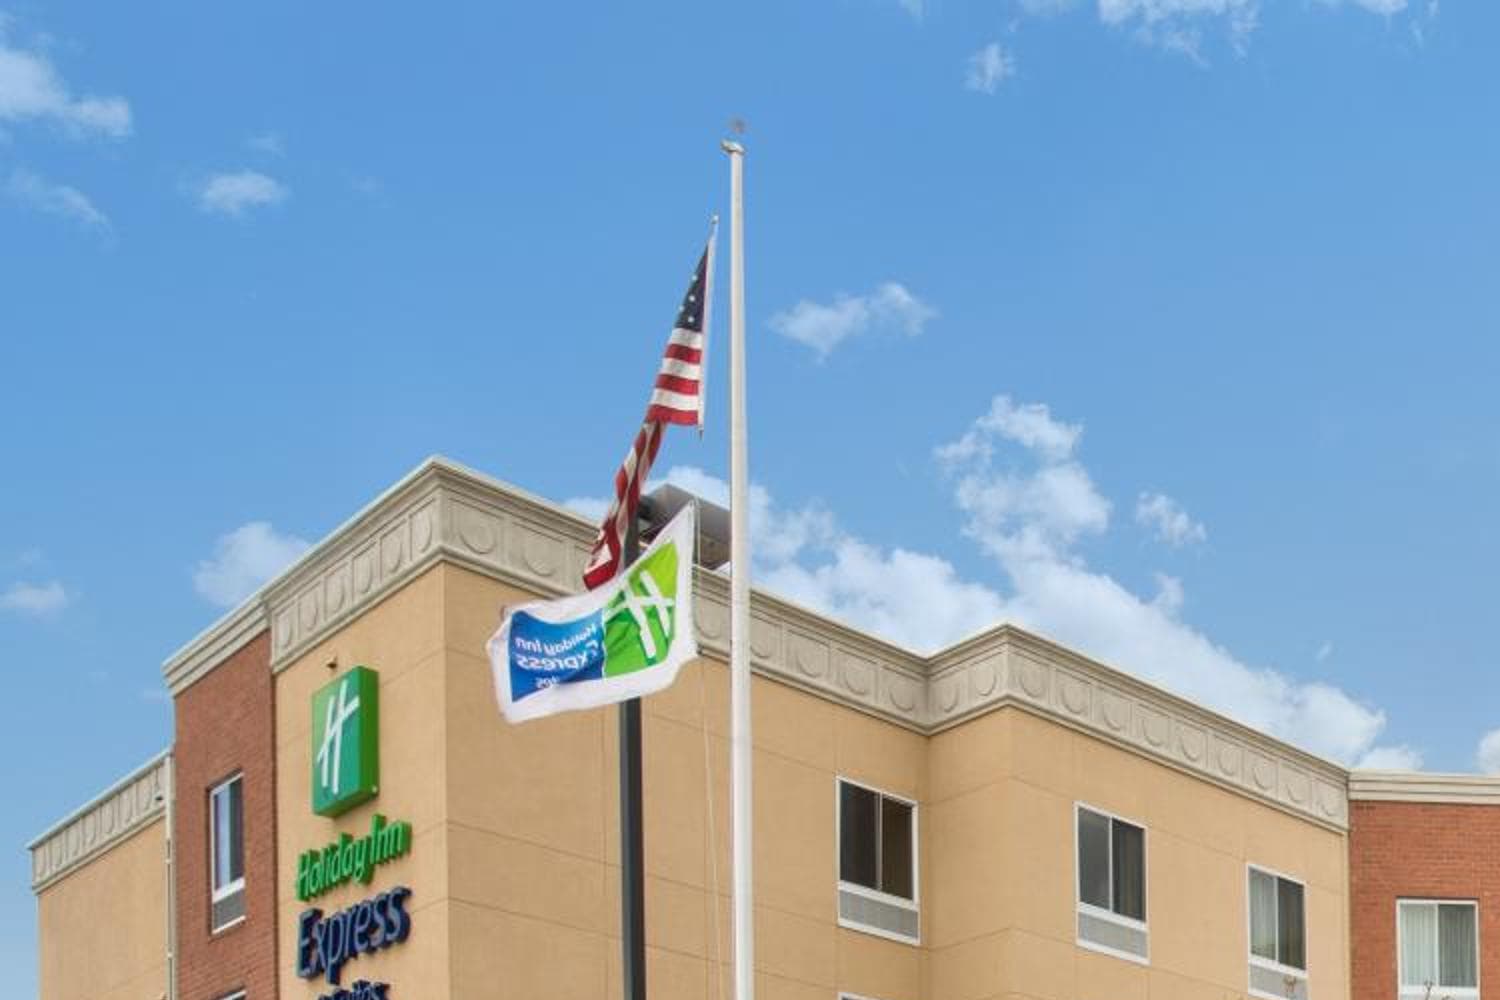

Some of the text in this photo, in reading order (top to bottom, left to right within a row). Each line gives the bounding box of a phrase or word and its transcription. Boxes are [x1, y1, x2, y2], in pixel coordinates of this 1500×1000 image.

[297, 814, 411, 898] Holiday Inn
[297, 886, 412, 985] Express
